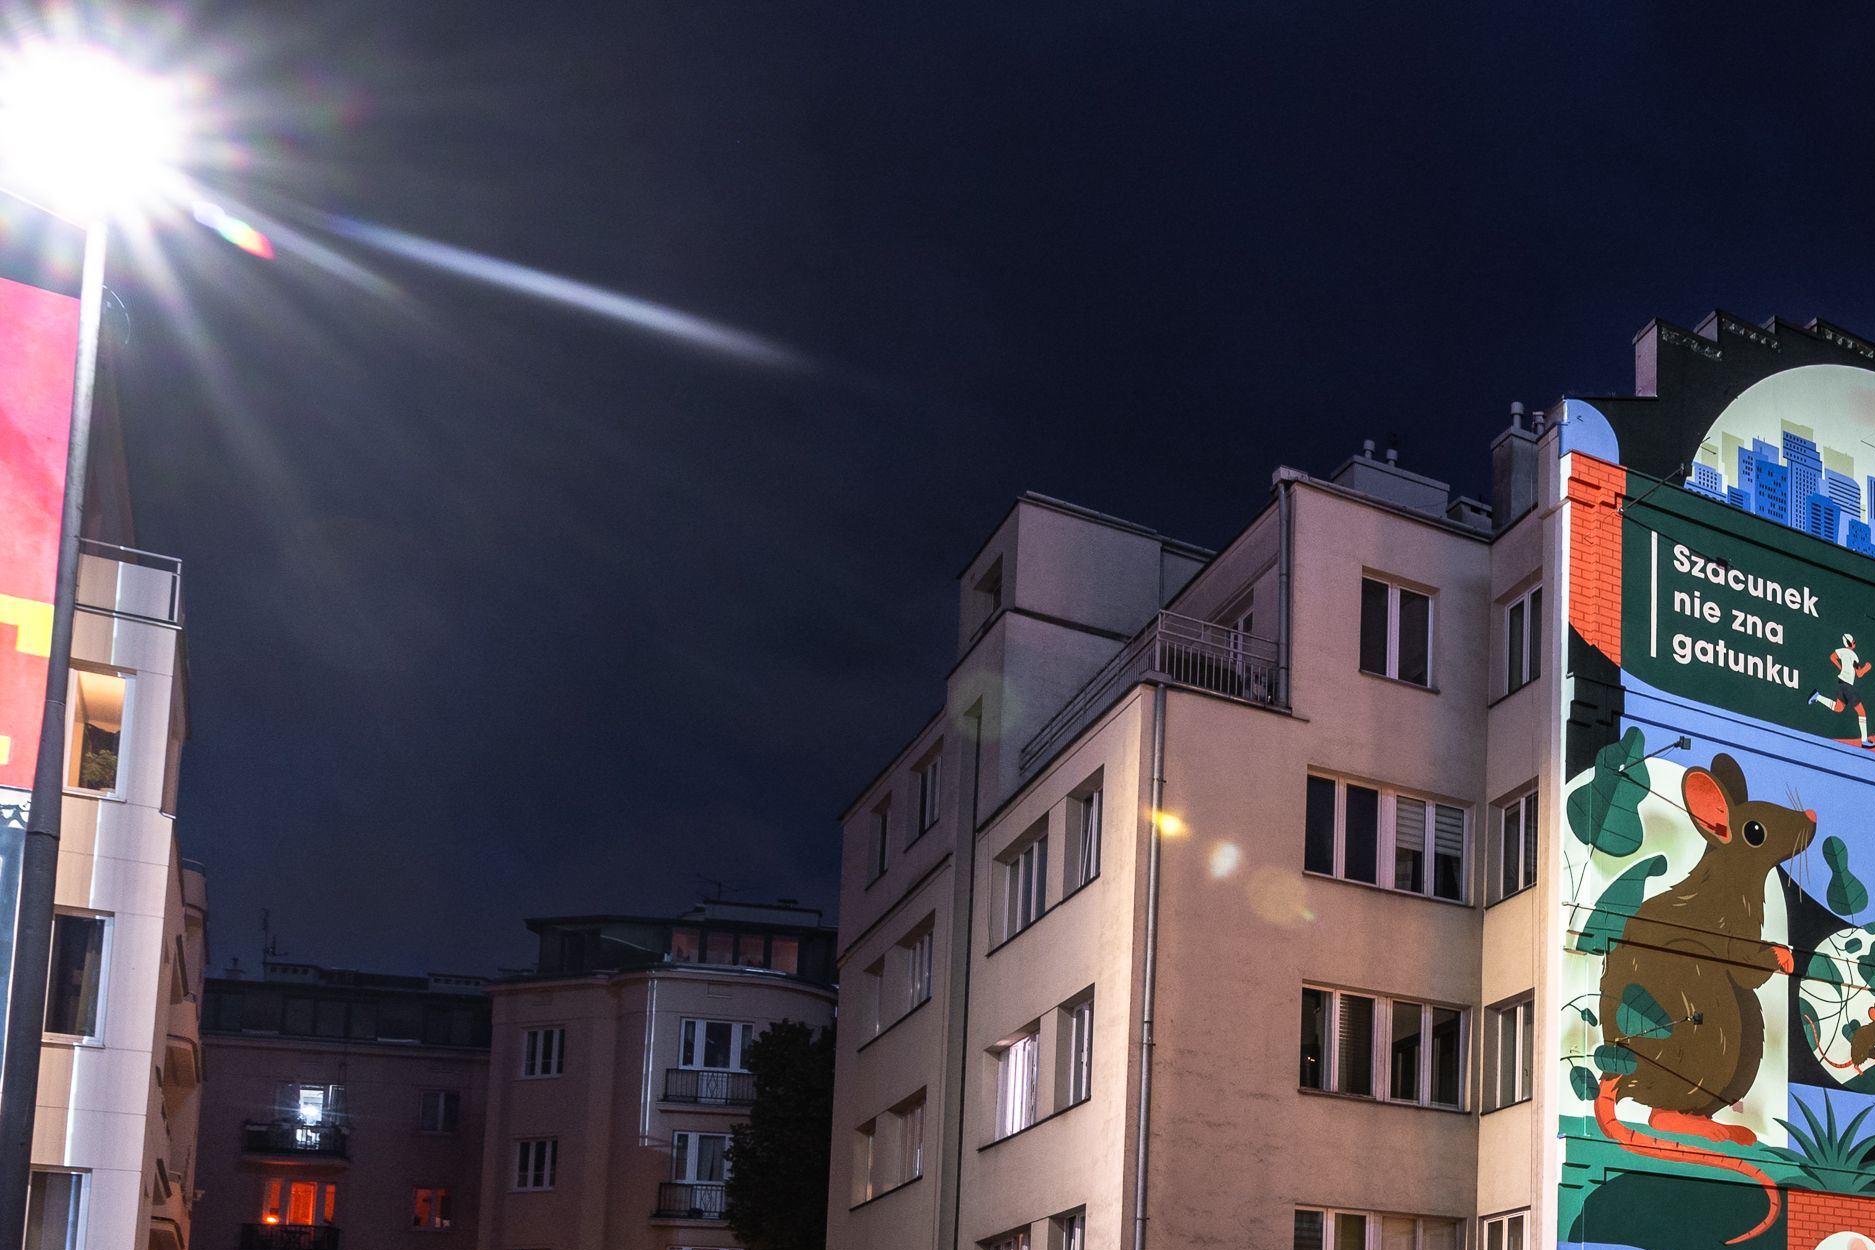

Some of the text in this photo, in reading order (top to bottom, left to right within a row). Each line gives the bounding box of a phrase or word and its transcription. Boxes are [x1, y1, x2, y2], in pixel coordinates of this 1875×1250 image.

[1673, 543, 1820, 618] Szacunek
[1673, 590, 1784, 645] nie zna
[1672, 633, 1800, 690] gatunku
